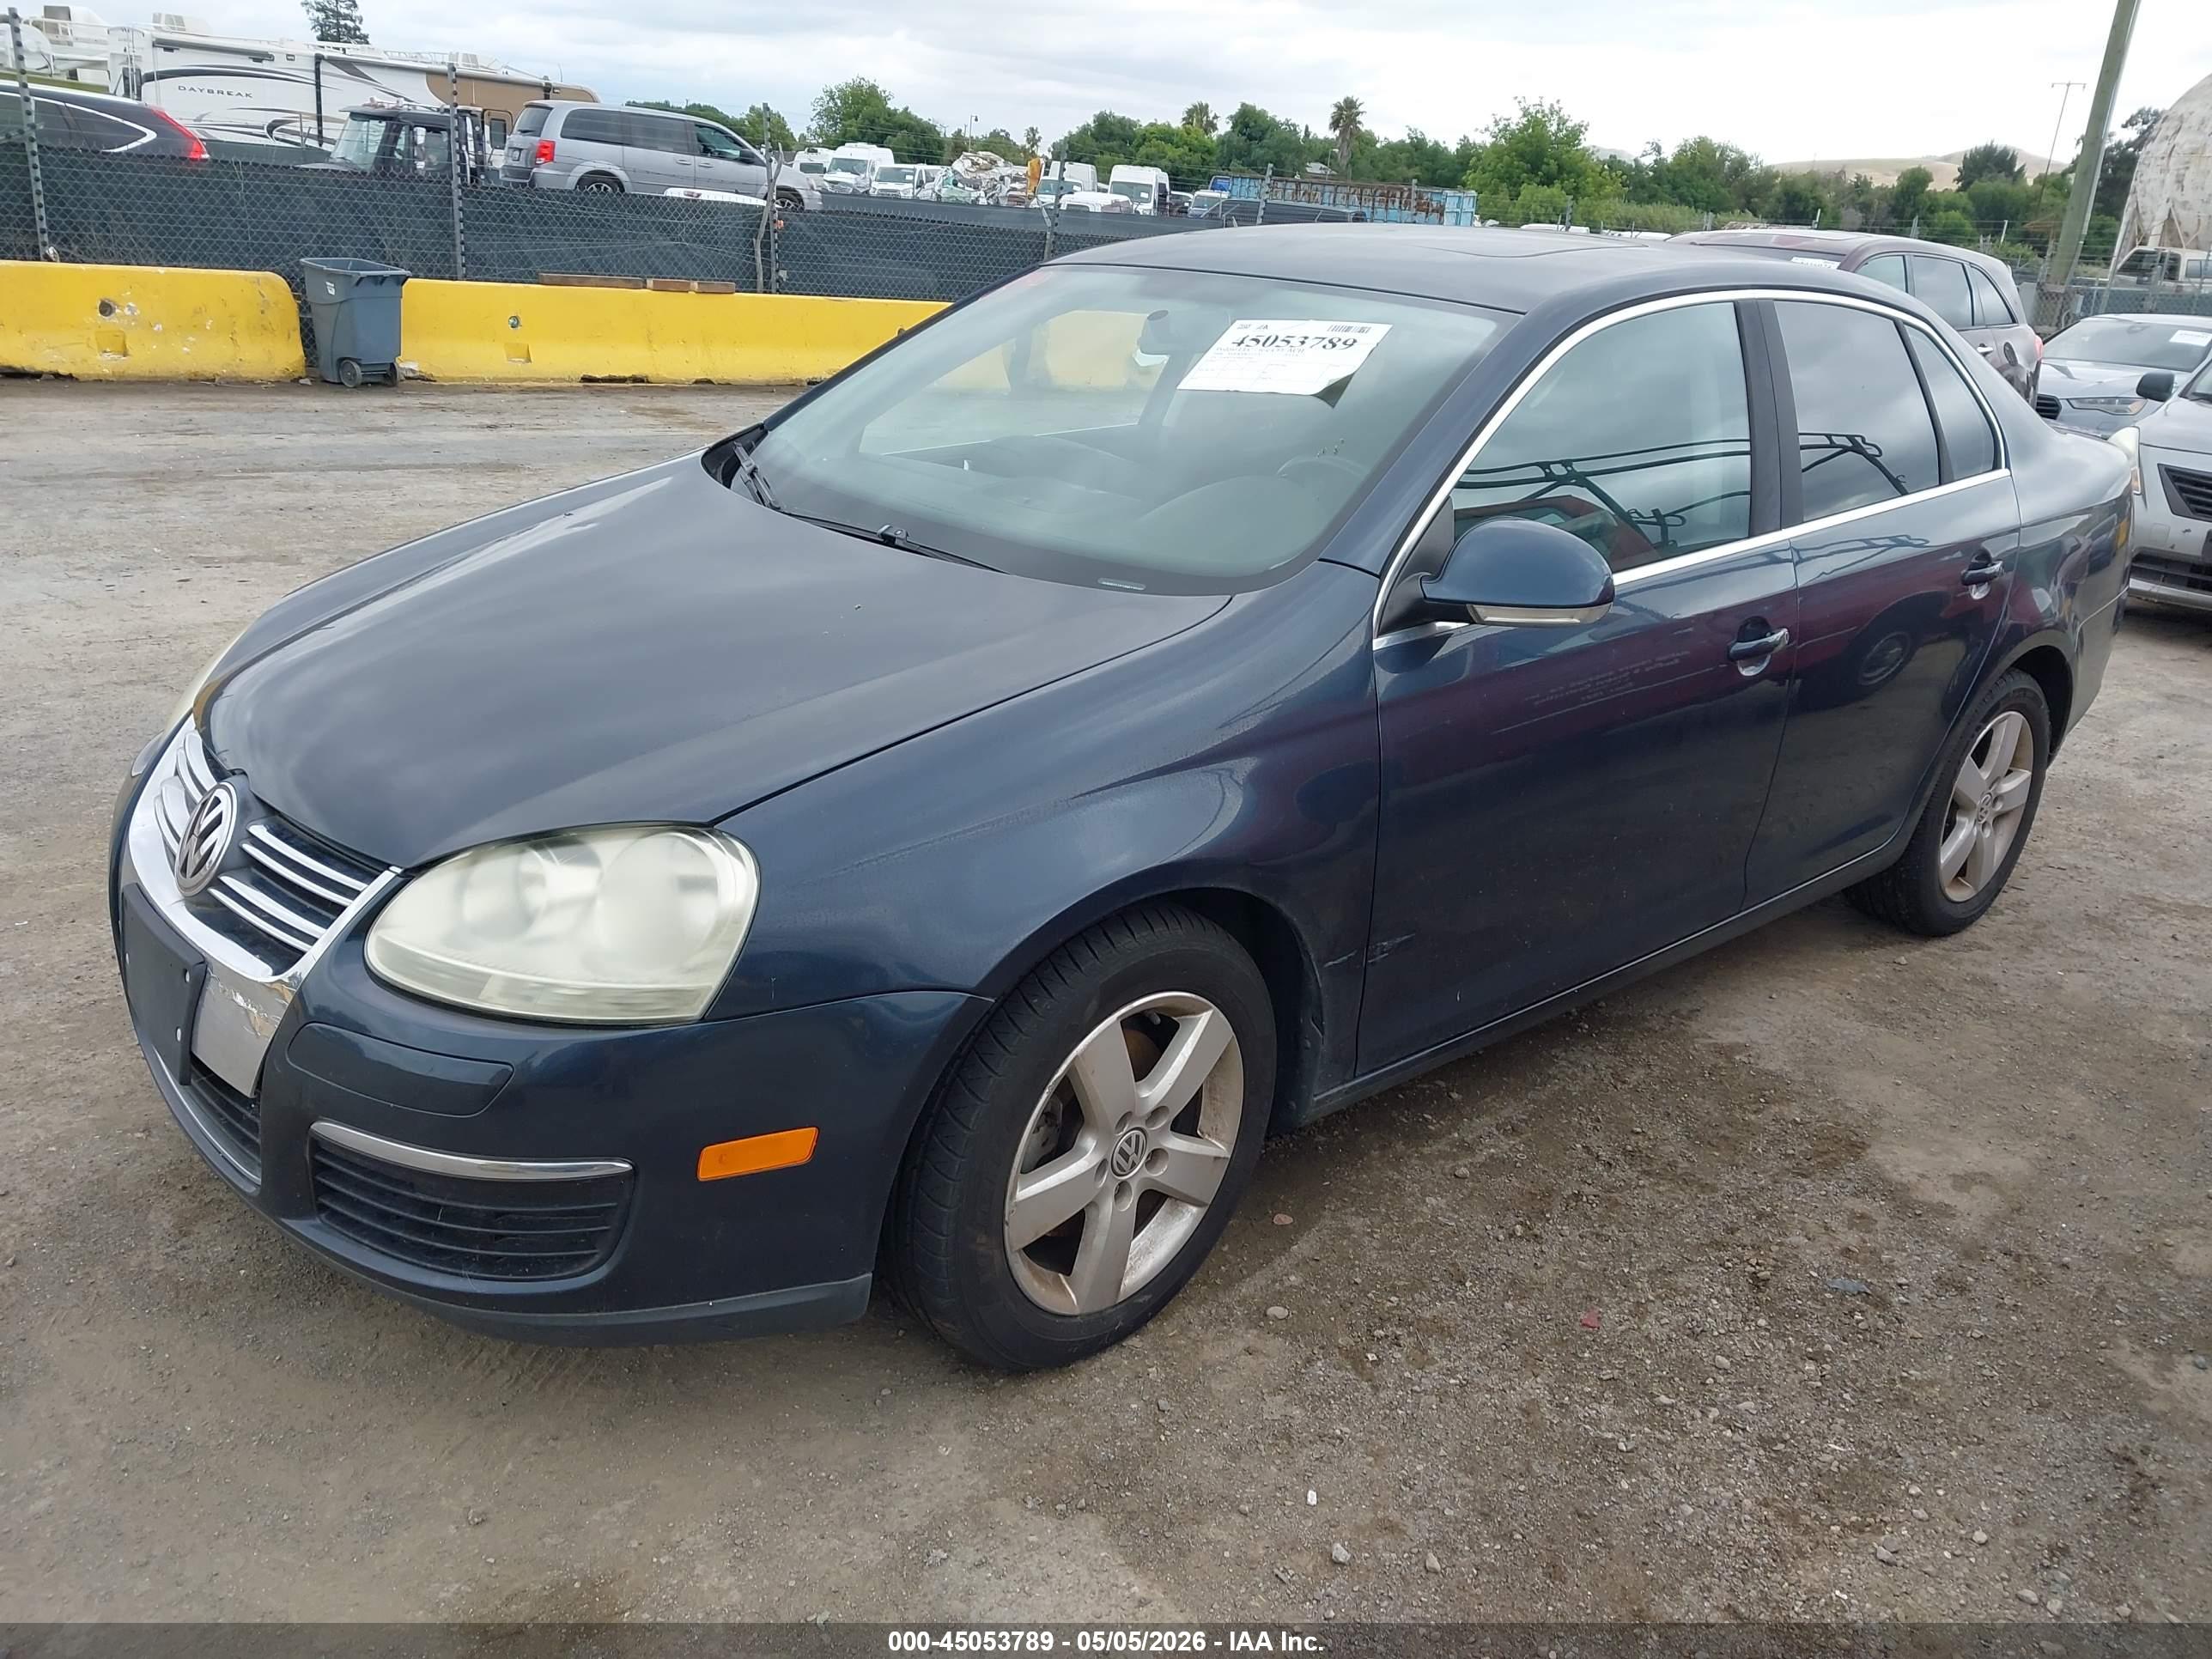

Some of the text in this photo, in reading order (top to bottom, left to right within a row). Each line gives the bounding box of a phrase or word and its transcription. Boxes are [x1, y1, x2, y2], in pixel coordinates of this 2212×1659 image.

[178, 85, 253, 99] DAYBREAK
[1231, 334, 1358, 350] 45053789
[177, 786, 234, 893] VW
[1112, 1128, 1147, 1177] VW
